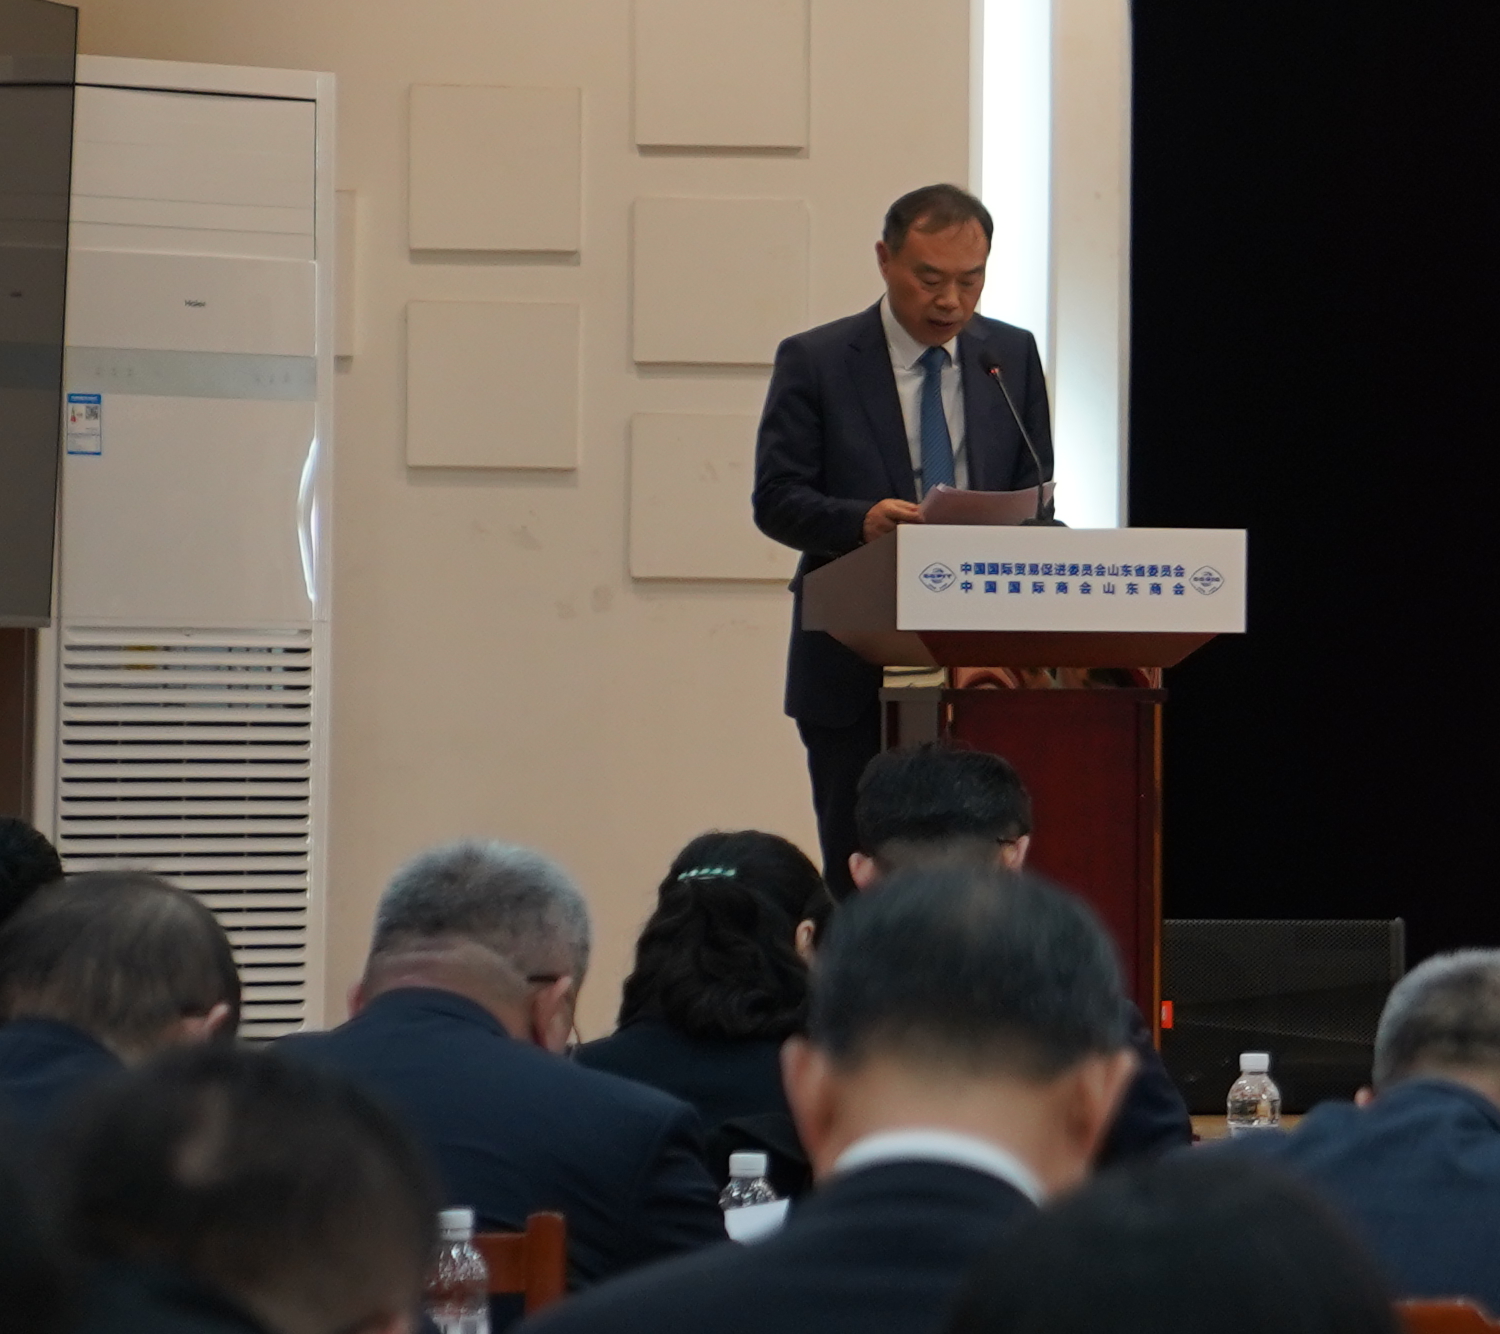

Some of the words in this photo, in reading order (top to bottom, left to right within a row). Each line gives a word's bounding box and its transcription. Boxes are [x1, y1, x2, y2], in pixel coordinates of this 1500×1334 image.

[960, 561, 1186, 578] 中国国际贸易促进委员会山东省委员会
[960, 580, 1186, 596] 中国国际商会山东商会
